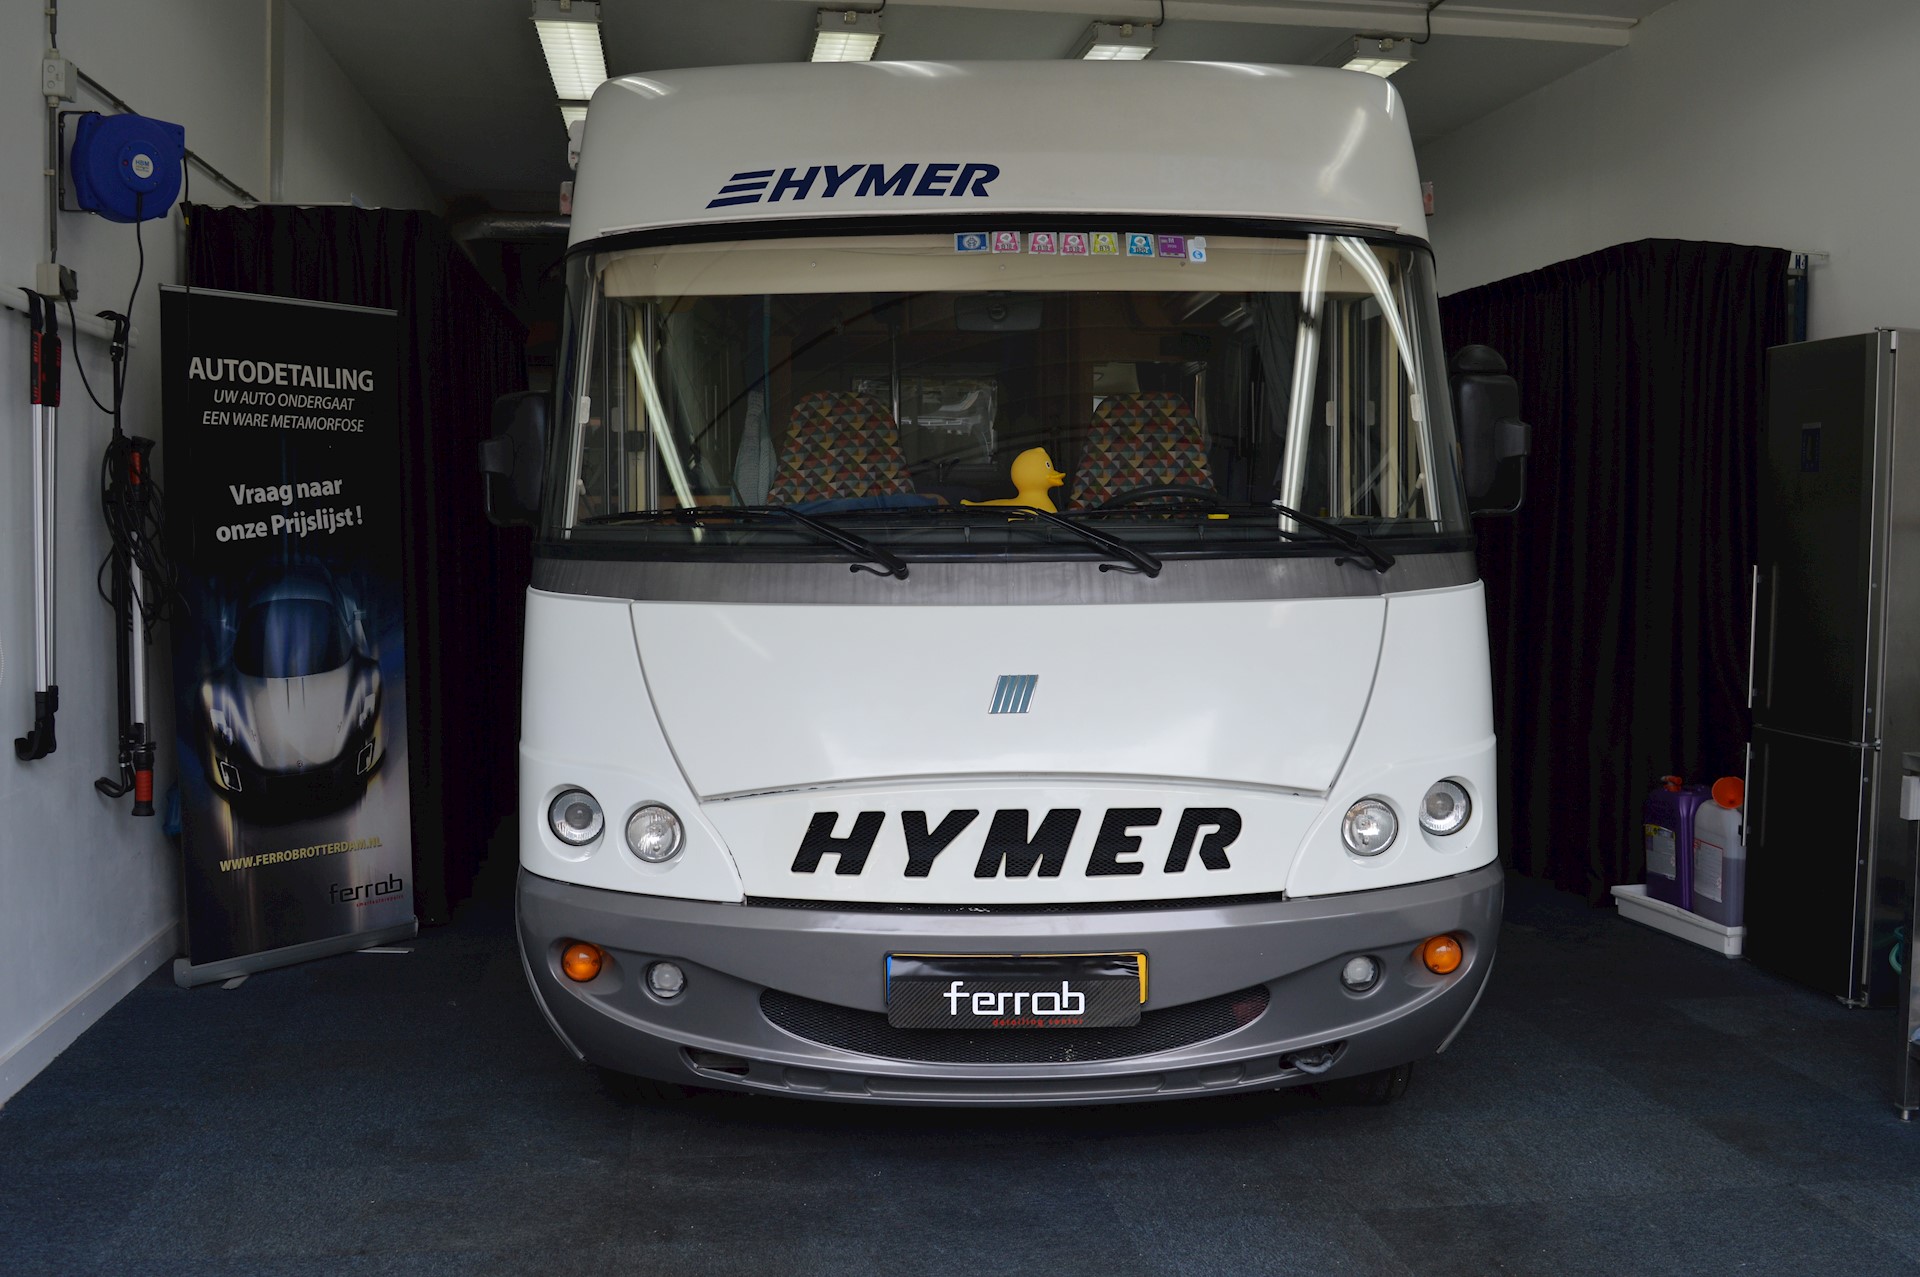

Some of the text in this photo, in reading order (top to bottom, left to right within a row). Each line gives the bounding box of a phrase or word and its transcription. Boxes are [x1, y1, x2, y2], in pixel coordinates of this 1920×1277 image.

[767, 163, 1000, 203] HYMER
[189, 356, 374, 392] AUTODETAILING
[213, 389, 355, 411] UW AUTO ONDERGAAT
[202, 411, 364, 433] EEN WARE METAMORFOSE
[229, 479, 343, 506] Vraag naar
[216, 521, 268, 543] onze
[219, 836, 382, 873] WWW.FERROBROTTERDAM.NL
[790, 806, 1243, 878] HYMER
